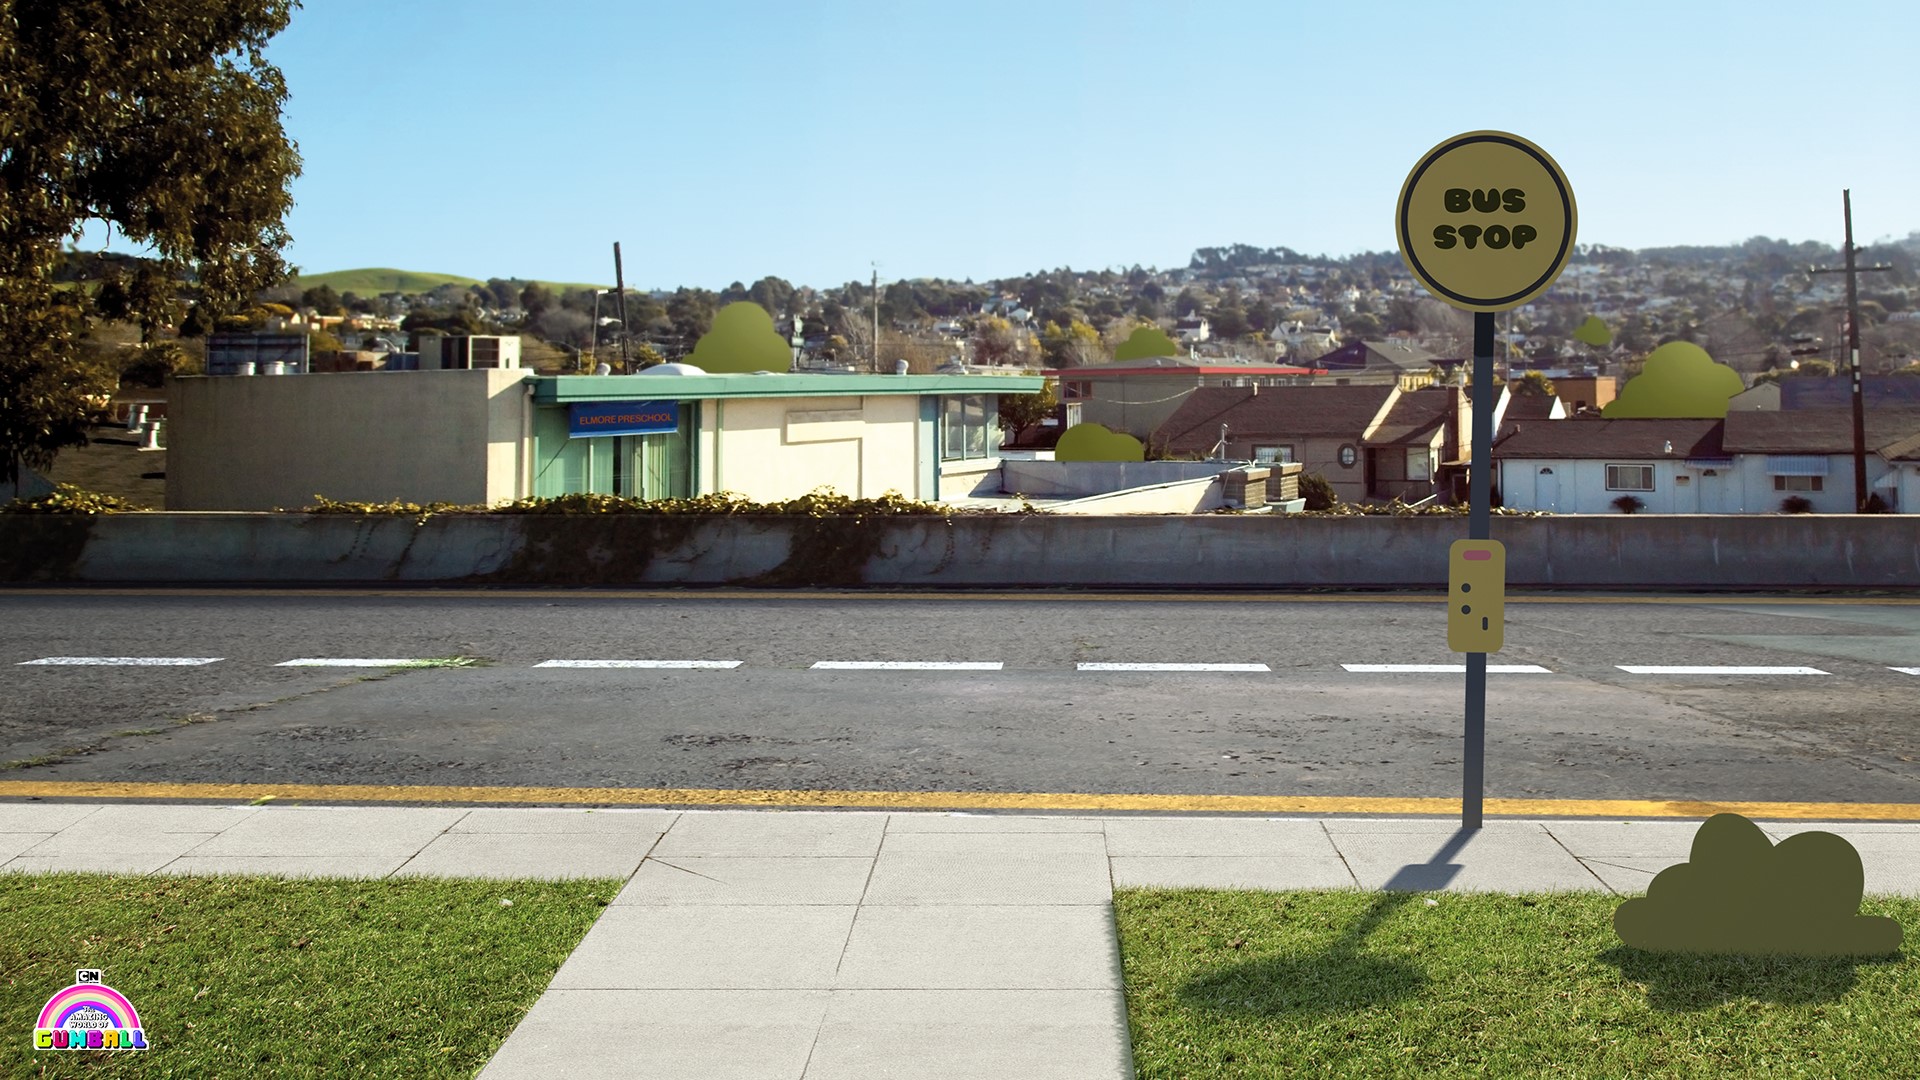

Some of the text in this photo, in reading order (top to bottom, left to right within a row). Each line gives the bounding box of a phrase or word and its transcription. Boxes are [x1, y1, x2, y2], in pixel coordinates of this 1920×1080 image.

[1444, 188, 1526, 213] BUS
[1433, 224, 1537, 250] STOP
[579, 413, 672, 425] ELMORE PRESCHOOL
